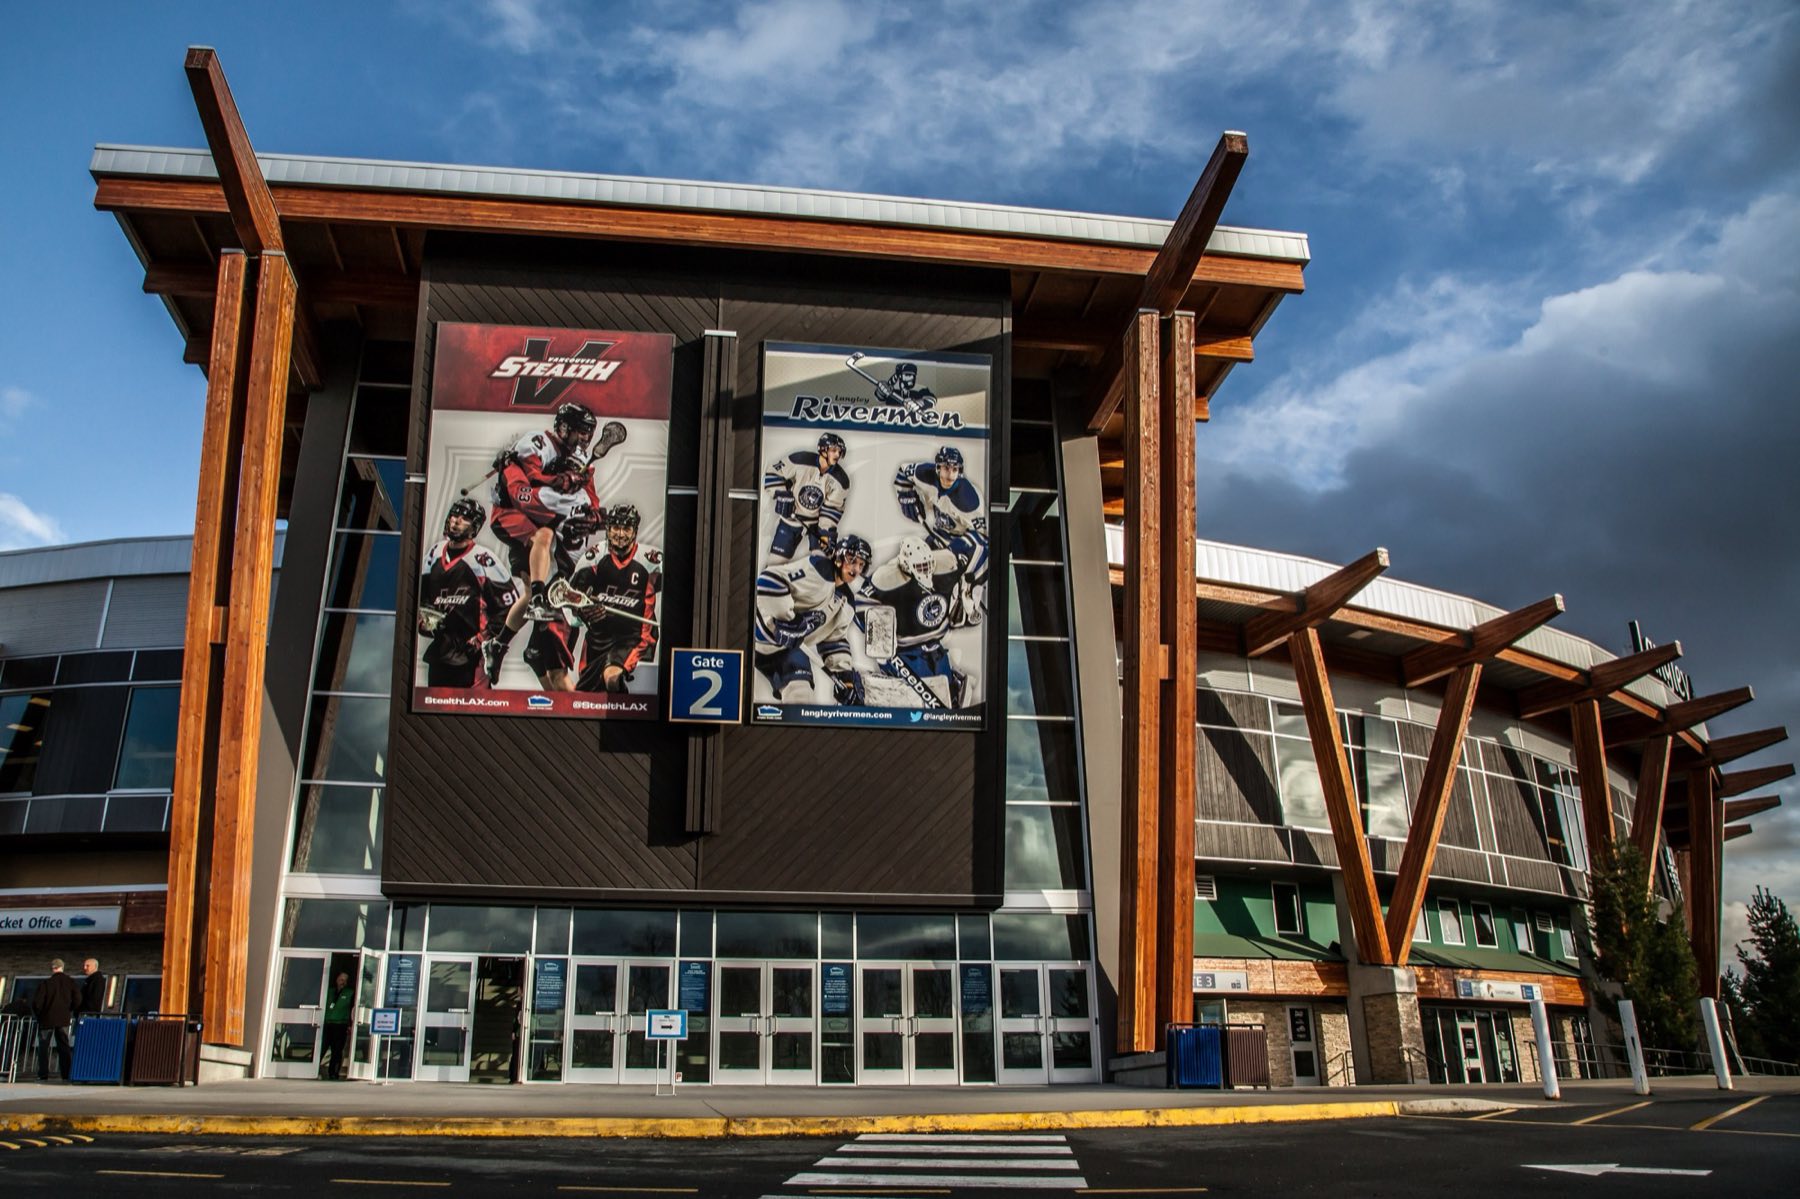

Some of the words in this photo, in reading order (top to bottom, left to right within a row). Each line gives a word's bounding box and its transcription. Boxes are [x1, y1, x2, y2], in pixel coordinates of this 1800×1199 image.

[491, 356, 622, 381] STEALTH
[789, 395, 965, 430] Rivermen
[631, 572, 639, 585] C
[502, 589, 519, 606] 91
[691, 655, 724, 668] Gate
[891, 656, 940, 710] Reebok
[689, 669, 722, 716] 2
[424, 696, 510, 707] StealthLAX.com
[572, 700, 648, 711] @StealthLAX
[801, 708, 893, 719] langleyrivermen.com
[923, 713, 982, 722] @langleyrivermen
[28, 916, 63, 929] Office
[1206, 976, 1212, 987] 3
